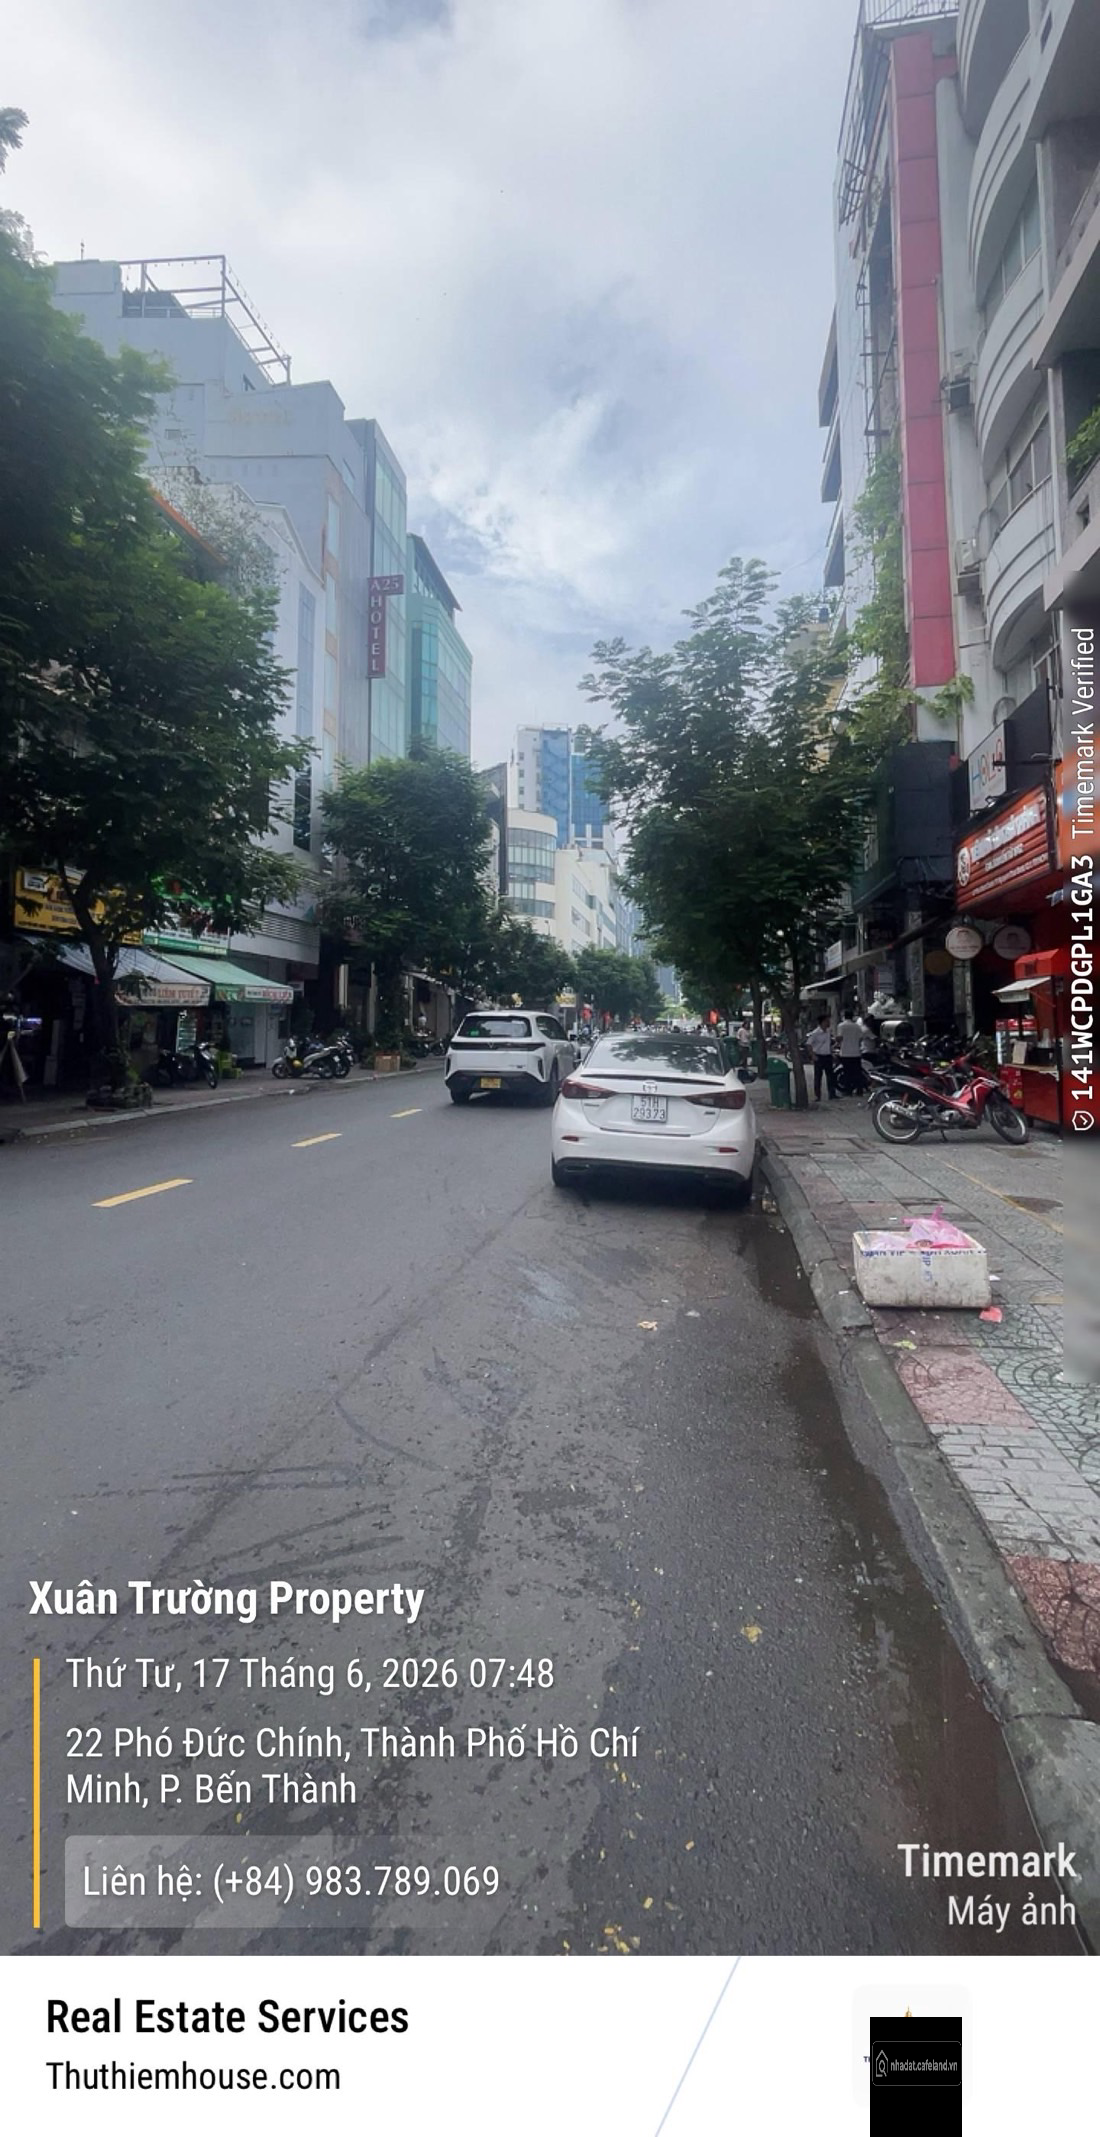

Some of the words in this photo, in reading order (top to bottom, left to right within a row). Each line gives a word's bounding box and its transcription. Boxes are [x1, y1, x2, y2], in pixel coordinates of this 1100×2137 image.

[369, 578, 400, 592] A25
[370, 594, 384, 672] HOTEL
[640, 1096, 660, 1108] 51H
[633, 1107, 665, 1120] 29373
